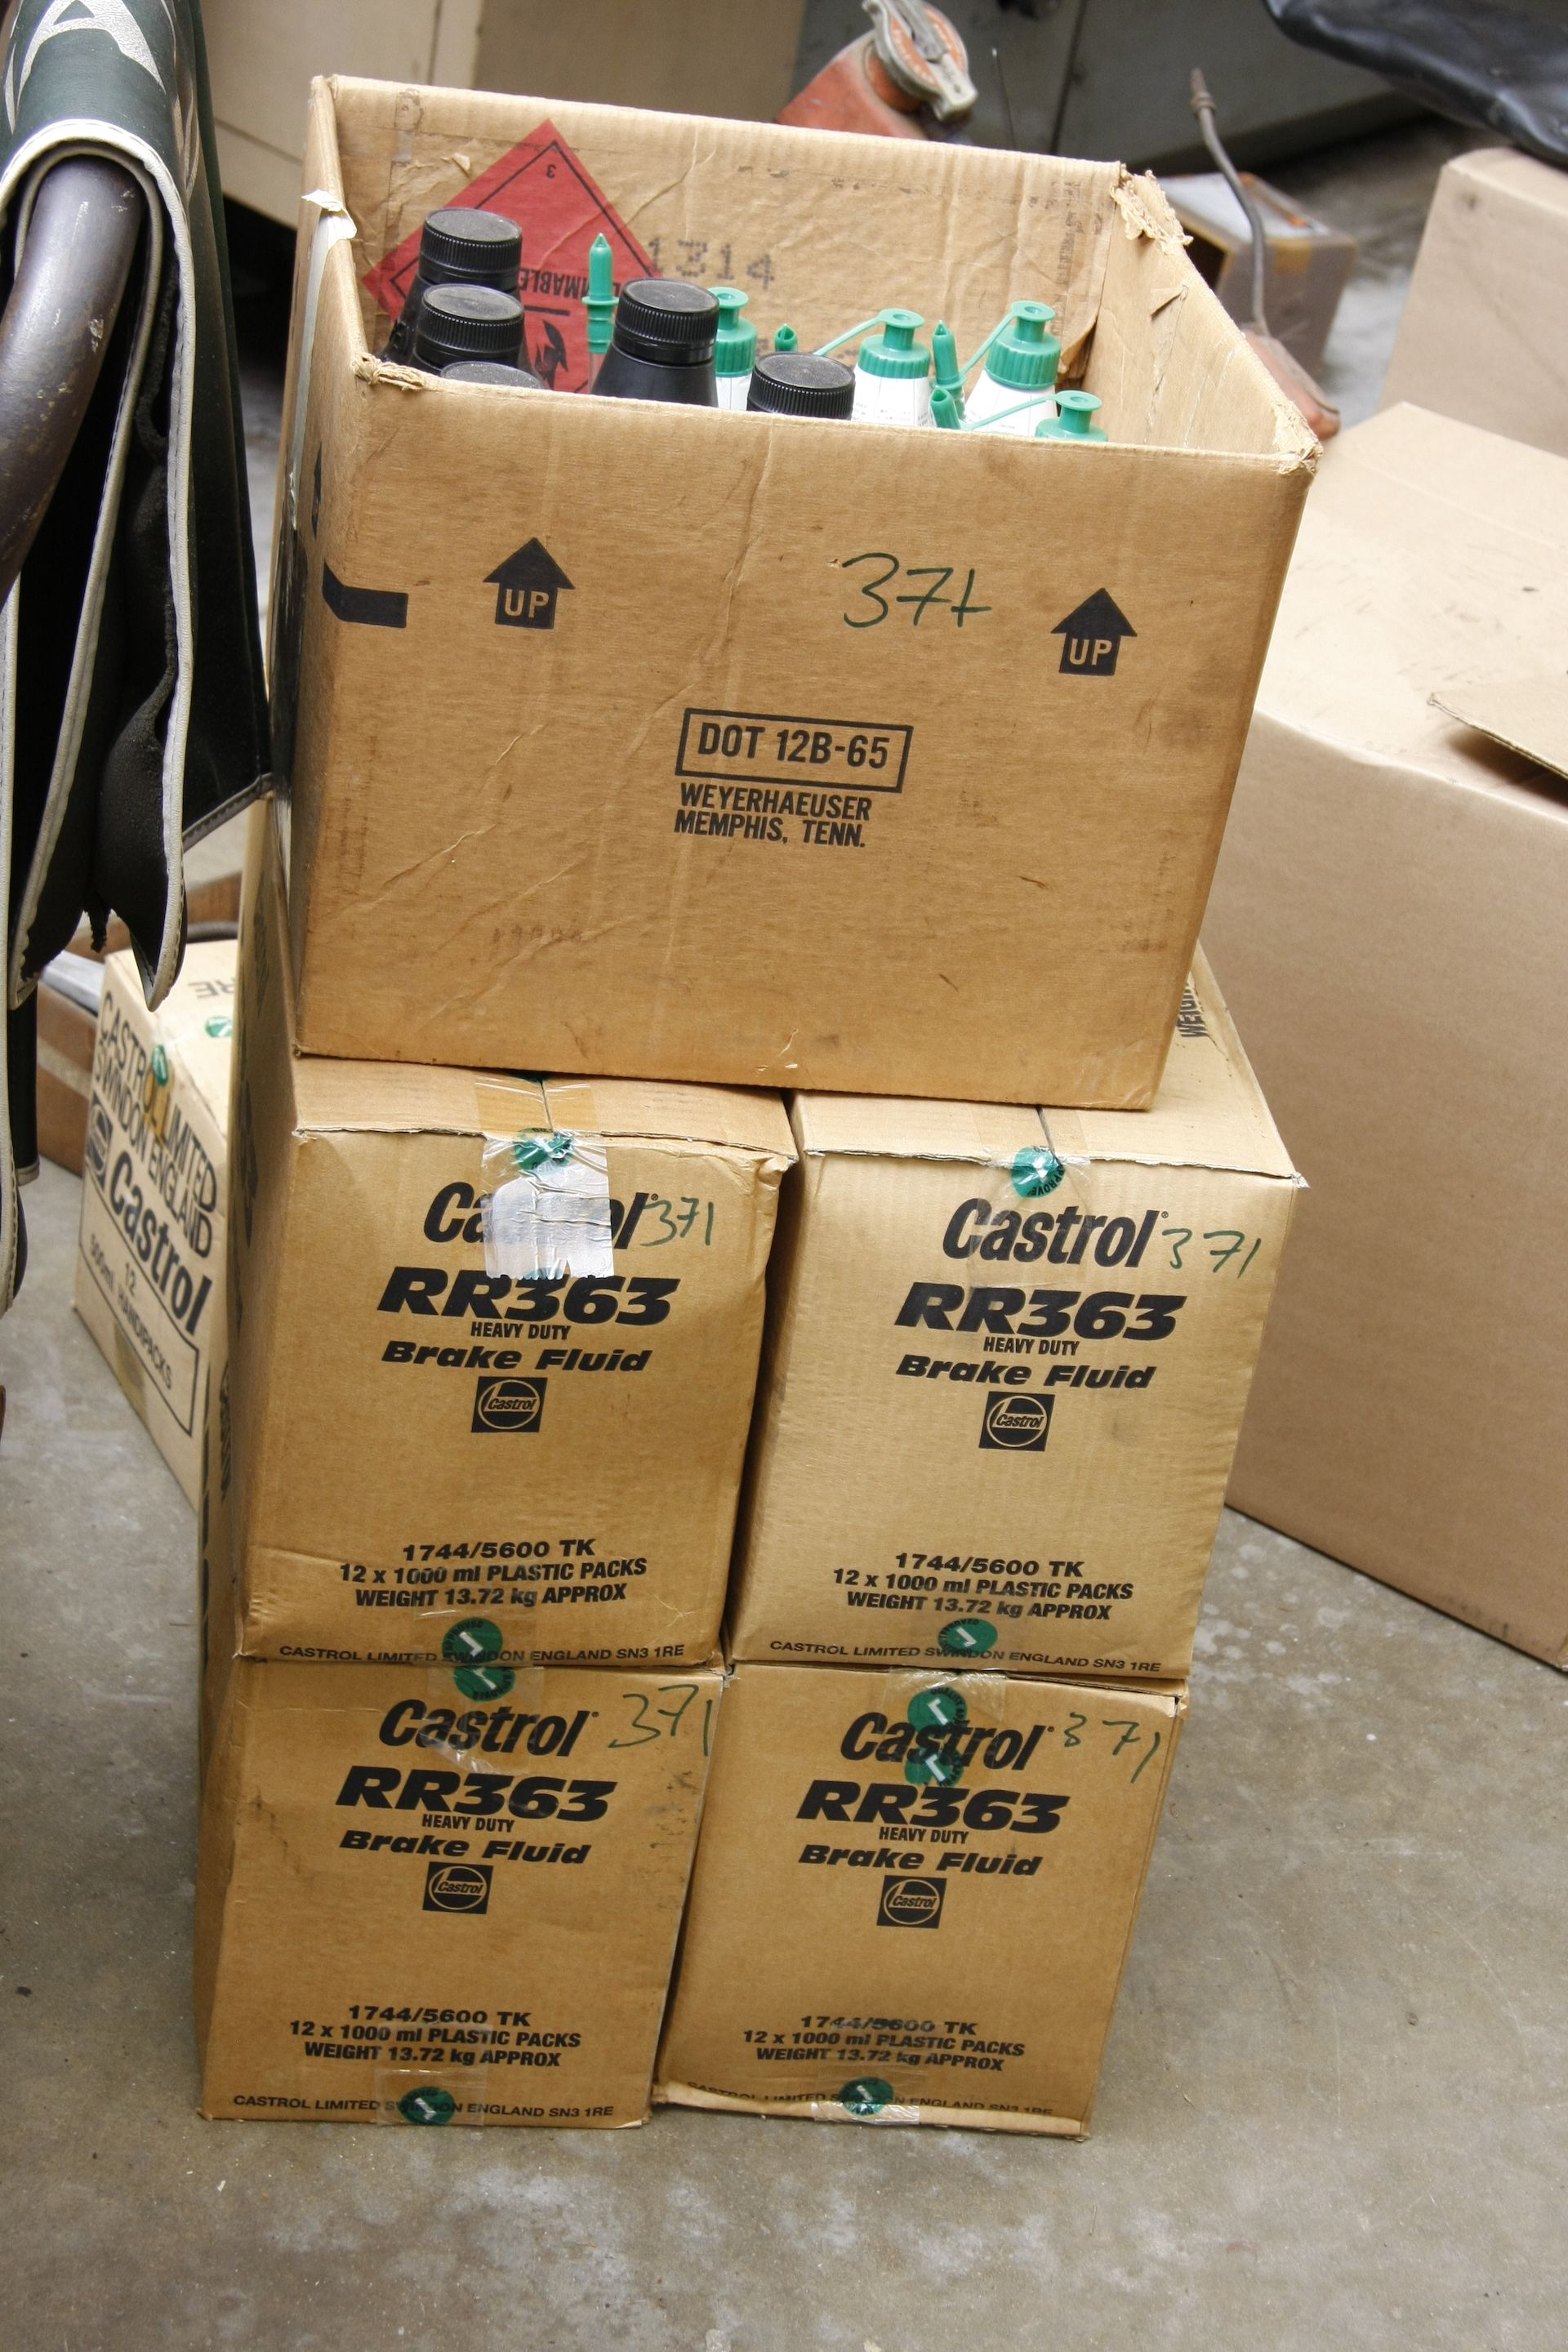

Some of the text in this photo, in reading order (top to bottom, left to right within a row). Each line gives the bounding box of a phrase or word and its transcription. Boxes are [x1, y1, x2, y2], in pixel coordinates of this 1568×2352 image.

[503, 587, 550, 618] UP
[1068, 638, 1113, 666] UP
[697, 721, 890, 770] DOT 12B-65
[679, 782, 873, 822] WEYERHAEUSER
[673, 808, 866, 849] MEMPHIS, TENN.
[639, 1196, 715, 1247] 371
[942, 1197, 1160, 1268] Castrol
[109, 1150, 213, 1337] Castrol
[1161, 1227, 1263, 1281] 371
[376, 1265, 681, 1326] RR363
[893, 1281, 1188, 1341] RR363
[470, 1321, 572, 1341] HEAVY DUTY
[982, 1335, 1080, 1356] HEAVY DUTY
[381, 1340, 653, 1373] Brake Fluid
[895, 1353, 1157, 1390] Brake Fluid
[488, 1395, 537, 1411] Castrol
[996, 1413, 1043, 1429] Castrol
[403, 1539, 596, 1561] 1744/5600 TK
[894, 1552, 1085, 1578] 1744/5600 TK
[340, 1557, 648, 1584] 12 x 1000 ml PLASTIC PACKS
[833, 1567, 1134, 1601] 12 x 1000 ml PLASTIC PACKS
[355, 1582, 628, 1608] WEIGHT 13.72 kg APPROX
[847, 1591, 1111, 1621] WEIGHT 13.72 kg APPROX
[278, 1645, 362, 1661] CASTROL
[368, 1651, 438, 1663] LIMITED
[533, 1648, 612, 1662] ENGLAND
[616, 1646, 649, 1659] SN3
[654, 1644, 684, 1658] 1RE
[769, 1640, 849, 1655] CASTROL
[853, 1644, 920, 1658] LIMITED
[1009, 1650, 1089, 1668] ENGLAND
[1093, 1658, 1126, 1671] SN3
[1129, 1660, 1161, 1673] 1RE
[378, 1699, 591, 1757] Castrol
[607, 1684, 714, 1757] 371
[840, 1712, 1047, 1771] Castrol
[1062, 1712, 1161, 1784] 371
[335, 1764, 618, 1822] RR363
[795, 1779, 1071, 1835] RR363
[421, 1812, 515, 1833] HEAVY DUTY
[878, 1826, 969, 1845] HEAVY DUTY
[339, 1829, 592, 1864] Brake Fluid
[798, 1843, 1044, 1877] Brake Fluid
[437, 1879, 484, 1895] Castrol
[892, 1894, 938, 1909] Castrol
[348, 2004, 532, 2027] 1744/5600 TK
[943, 2020, 978, 2036] TK
[289, 2020, 581, 2048] 12 x 1000 ml PLASTIC PACKS
[743, 2029, 1027, 2057] 12 x 1000 ml PLASTIC PACKS
[304, 2042, 561, 2067] WEIGHT 13.72 kg APPROX
[756, 2047, 1004, 2072] WEIGHT 13.72 kg APPROX
[234, 2094, 310, 2109] CASTROL
[314, 2099, 381, 2111] LIMITED
[466, 2101, 546, 2117] ENGLAND
[549, 2105, 580, 2118] SN3
[584, 2105, 614, 2118] 1RE
